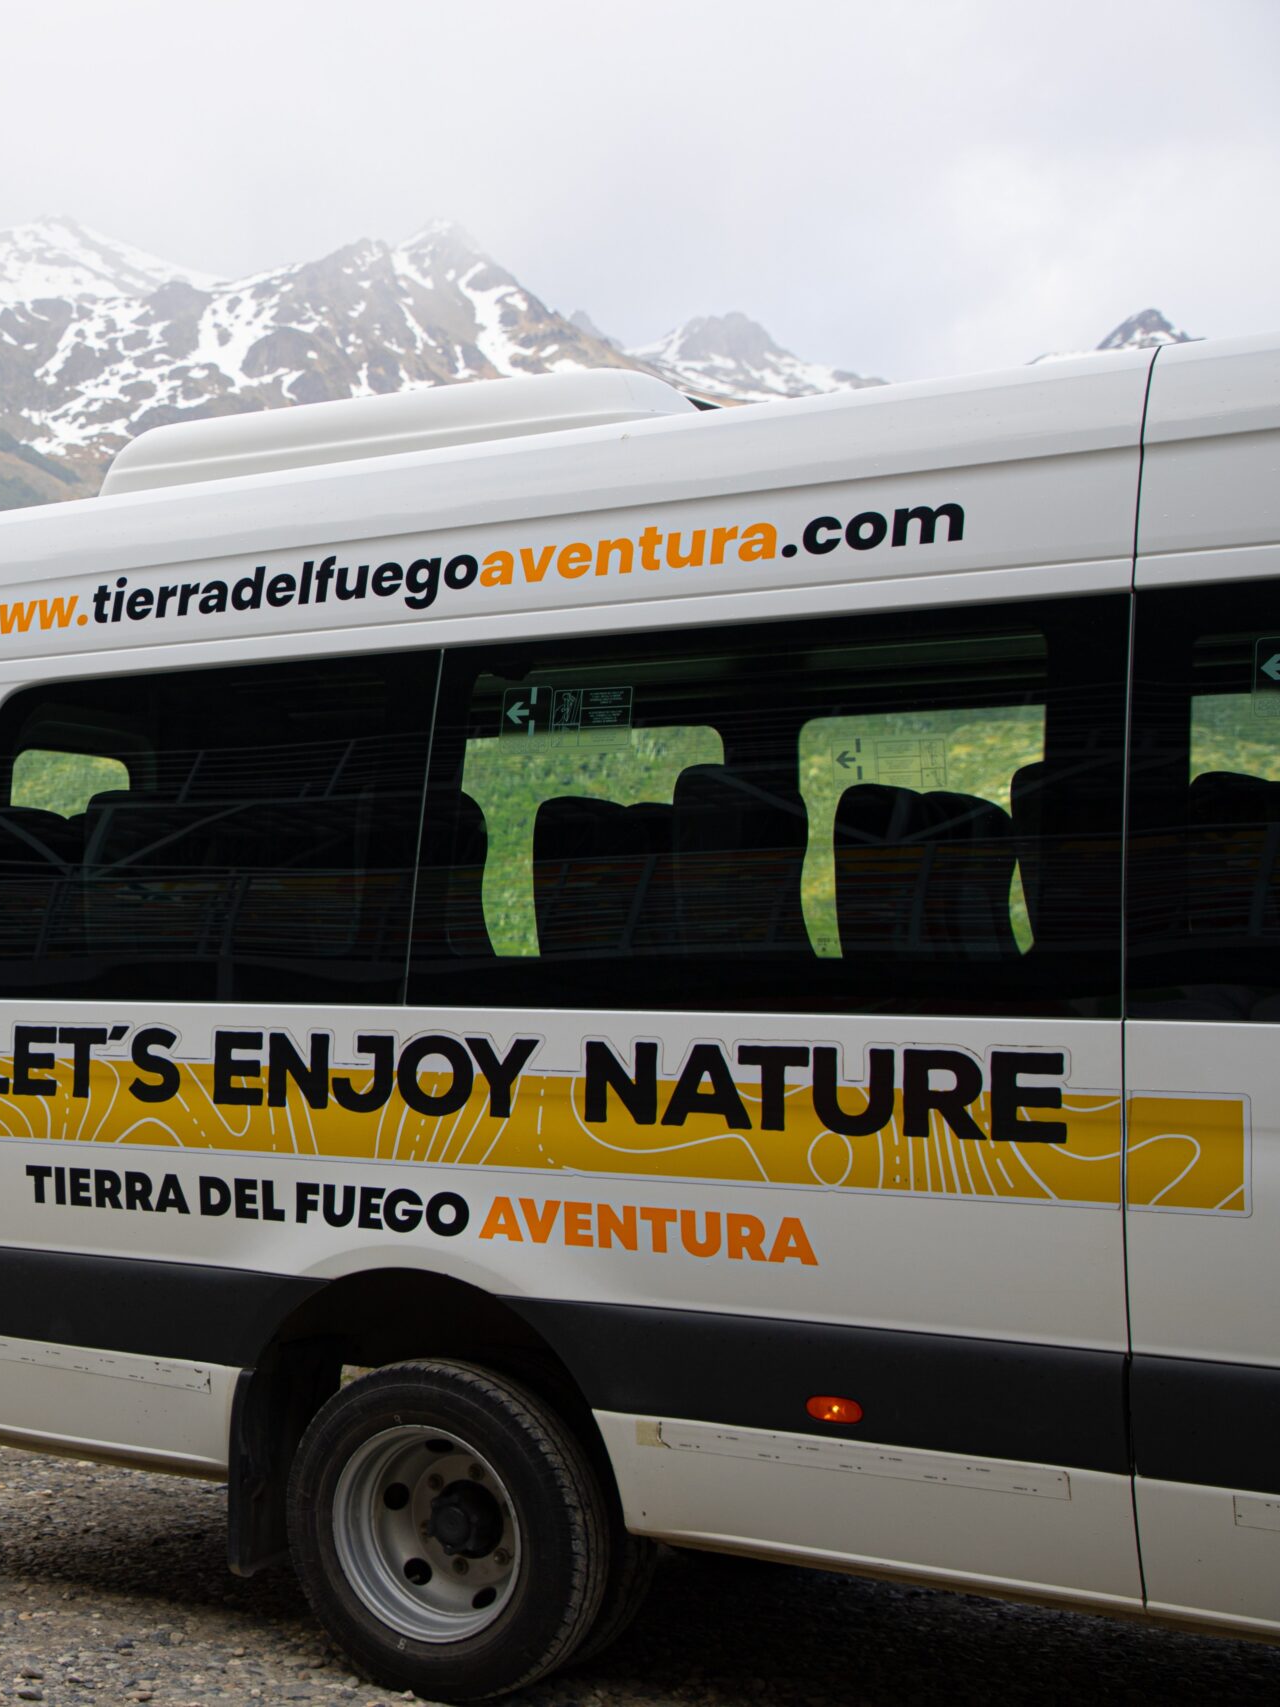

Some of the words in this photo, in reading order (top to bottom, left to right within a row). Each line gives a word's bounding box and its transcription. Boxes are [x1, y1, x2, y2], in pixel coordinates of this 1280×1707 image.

[212, 1030, 540, 1119] ENJOY
[583, 1041, 1068, 1144] NATURE
[25, 1164, 191, 1215] TIERRA
[199, 1175, 286, 1222] DEL
[295, 1182, 470, 1237] FUEGO
[478, 1196, 819, 1266] AVENTURA
